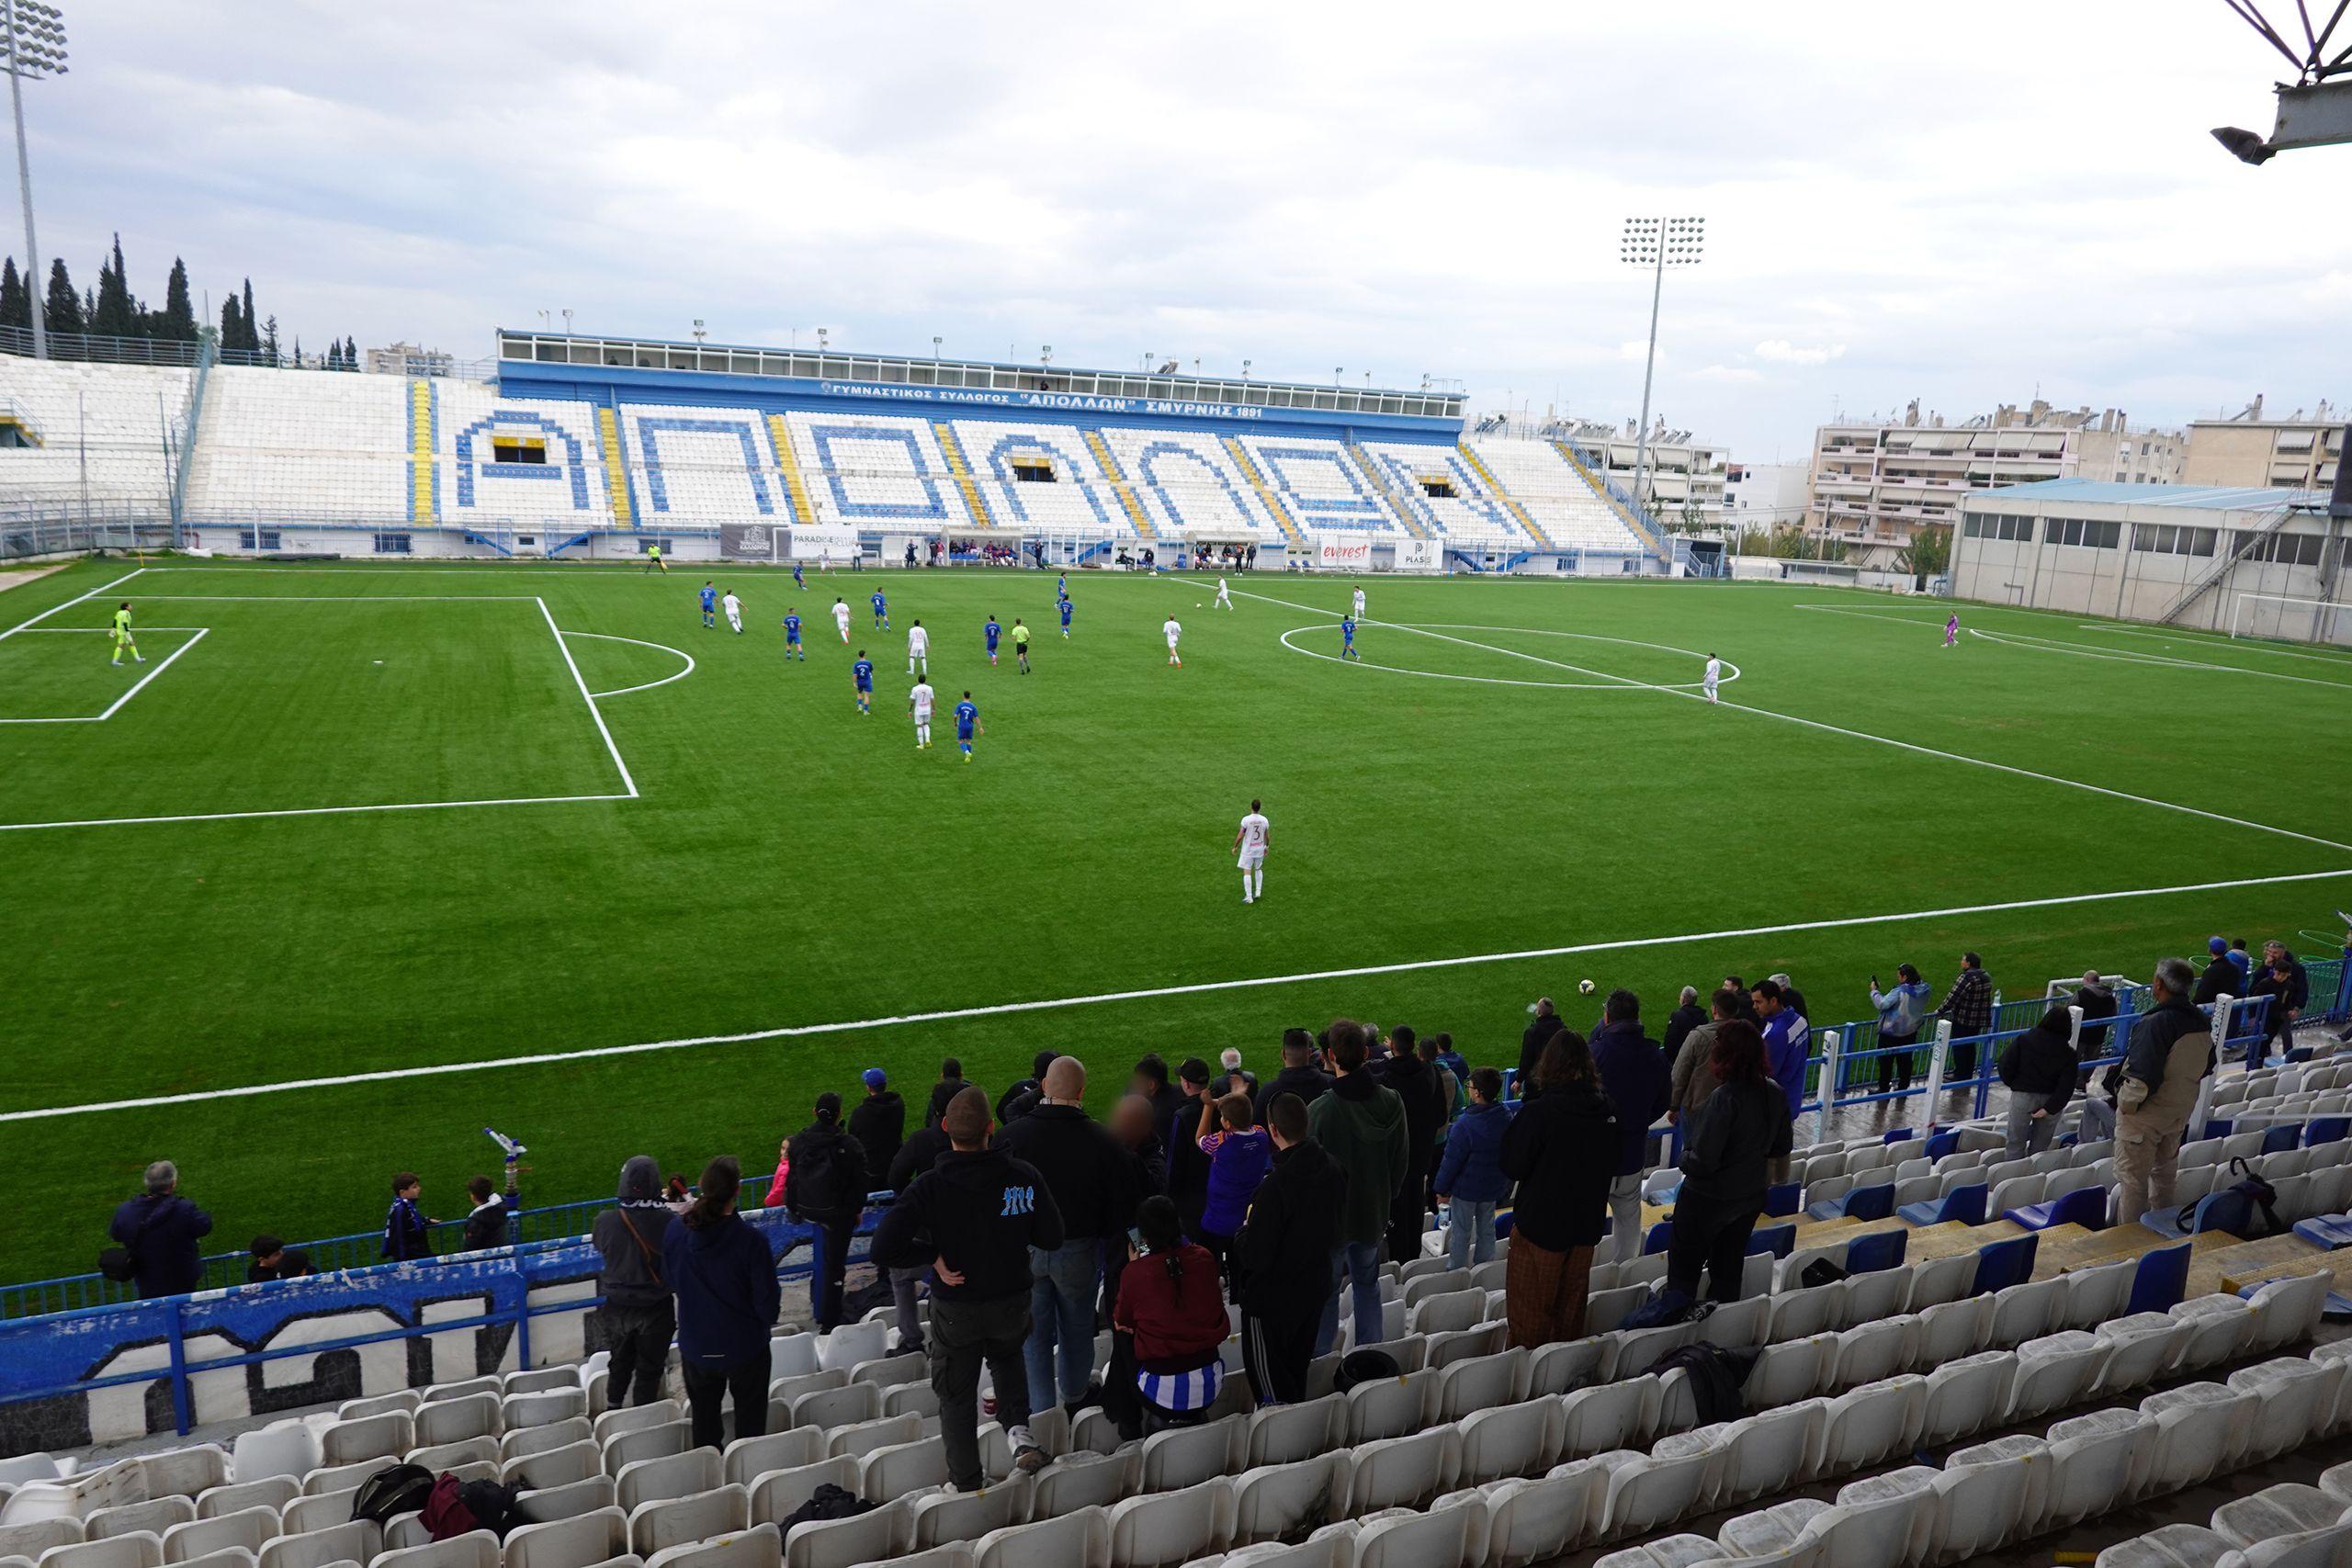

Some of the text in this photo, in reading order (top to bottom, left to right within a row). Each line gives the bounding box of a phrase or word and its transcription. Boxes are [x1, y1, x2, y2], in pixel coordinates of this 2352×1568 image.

[832, 385, 933, 398] ΓΥΜΝΑΣΤΙΚΟΣ
[939, 391, 1009, 403] ΣΥΛΛΟΓΟΣ
[1146, 400, 1233, 416] ΣΜΥΡΝΗΣ
[1236, 406, 1262, 418] 1891
[1323, 543, 1368, 558] everest
[1253, 825, 1261, 840] 3
